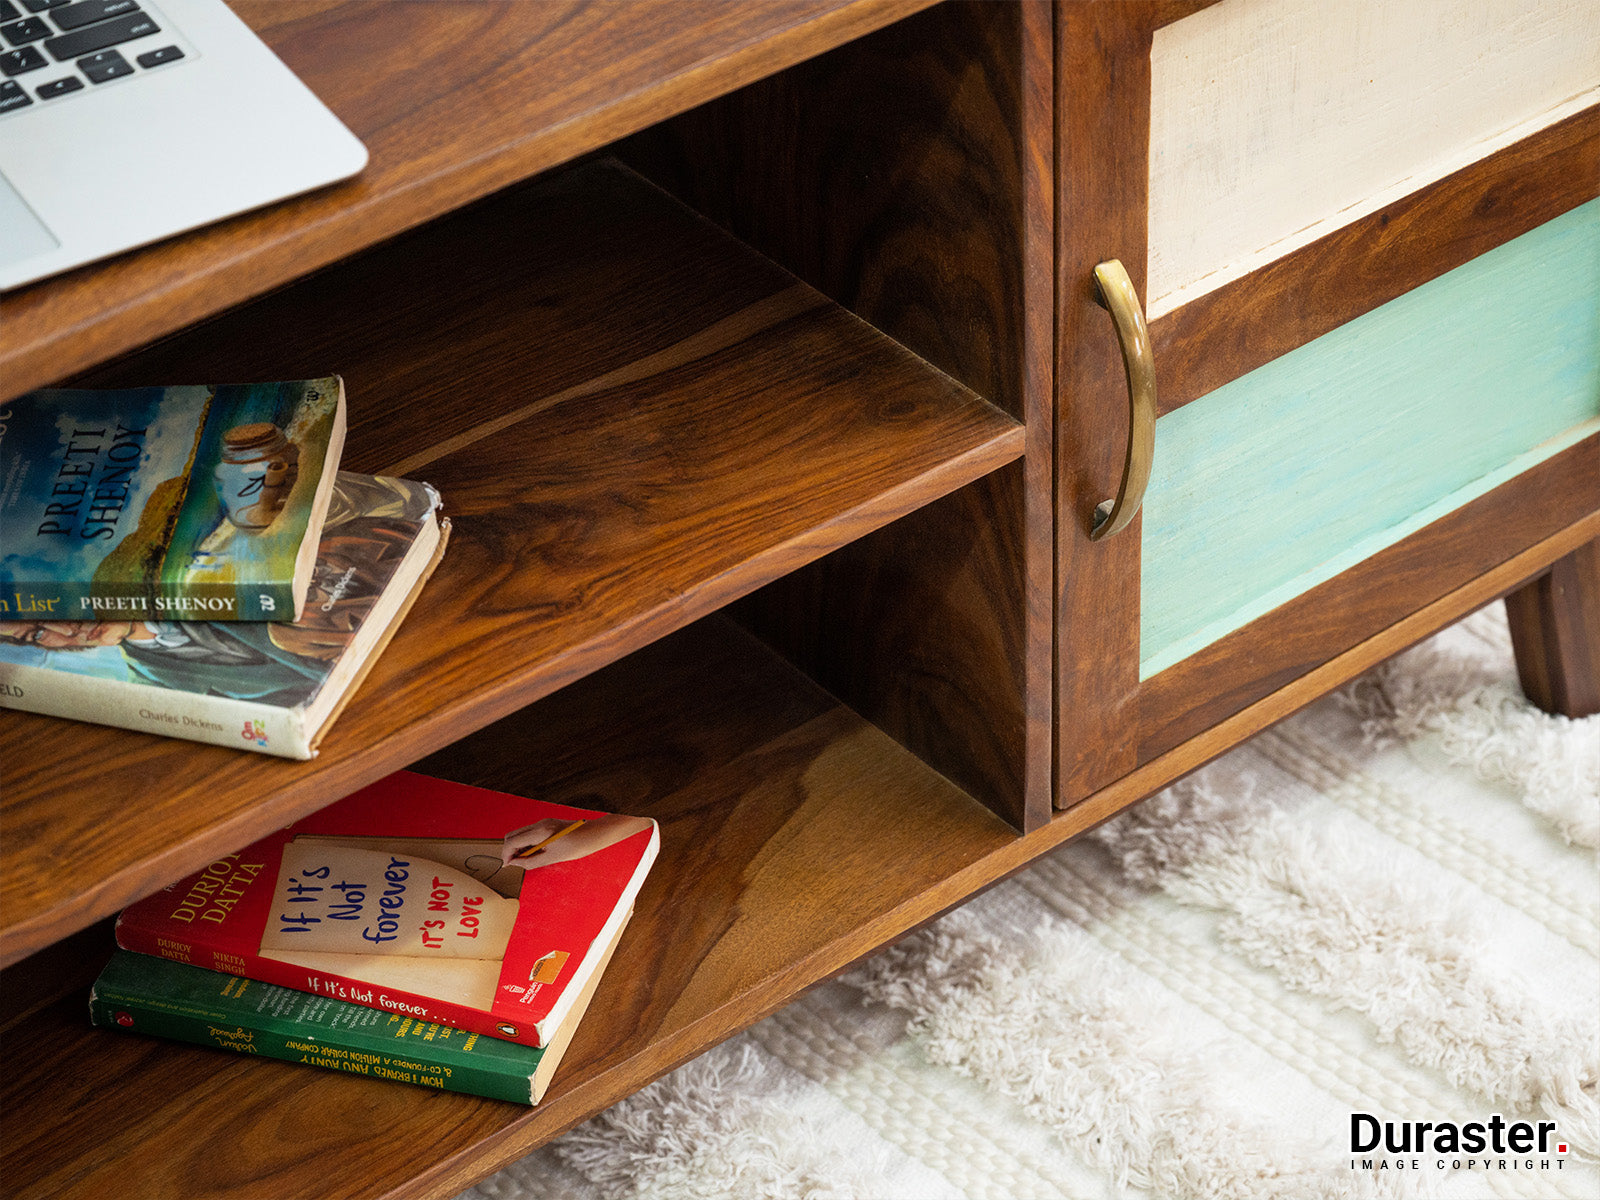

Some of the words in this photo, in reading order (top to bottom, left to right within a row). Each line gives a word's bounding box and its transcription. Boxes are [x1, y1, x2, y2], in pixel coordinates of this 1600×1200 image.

[37, 429, 106, 536] PREETI
[80, 424, 148, 540] SHENOY
[14, 593, 60, 612] List
[80, 597, 148, 610] PREETI
[155, 597, 235, 611] SHENOY
[139, 708, 179, 724] Charles
[182, 715, 223, 732] Dickens
[287, 866, 330, 902] It's
[201, 863, 265, 924] DATTA
[327, 880, 367, 920] Not
[362, 857, 410, 944] forever
[428, 876, 454, 912] NOT
[280, 911, 321, 932] If
[456, 896, 484, 938] LOVE
[419, 919, 446, 949] IT'S
[161, 948, 191, 962] DATTA
[213, 952, 246, 966] NIKITA
[215, 962, 246, 976] SINGH
[308, 977, 320, 992] If
[325, 981, 347, 998] It's
[351, 987, 373, 1003] Not
[379, 995, 428, 1017] forever
[208, 1025, 254, 1043] Agarwal
[215, 1037, 257, 1053] Varun
[285, 1041, 319, 1054] COMPANY
[321, 1046, 348, 1058] DOLLAR
[300, 1055, 339, 1069] AUNTY
[343, 1061, 369, 1075] ANU
[383, 1057, 391, 1065] A
[392, 1060, 441, 1074] CO-FOUNDED
[374, 1066, 411, 1082] BRAVED
[443, 1067, 452, 1077] &
[420, 1075, 444, 1088] HOW
